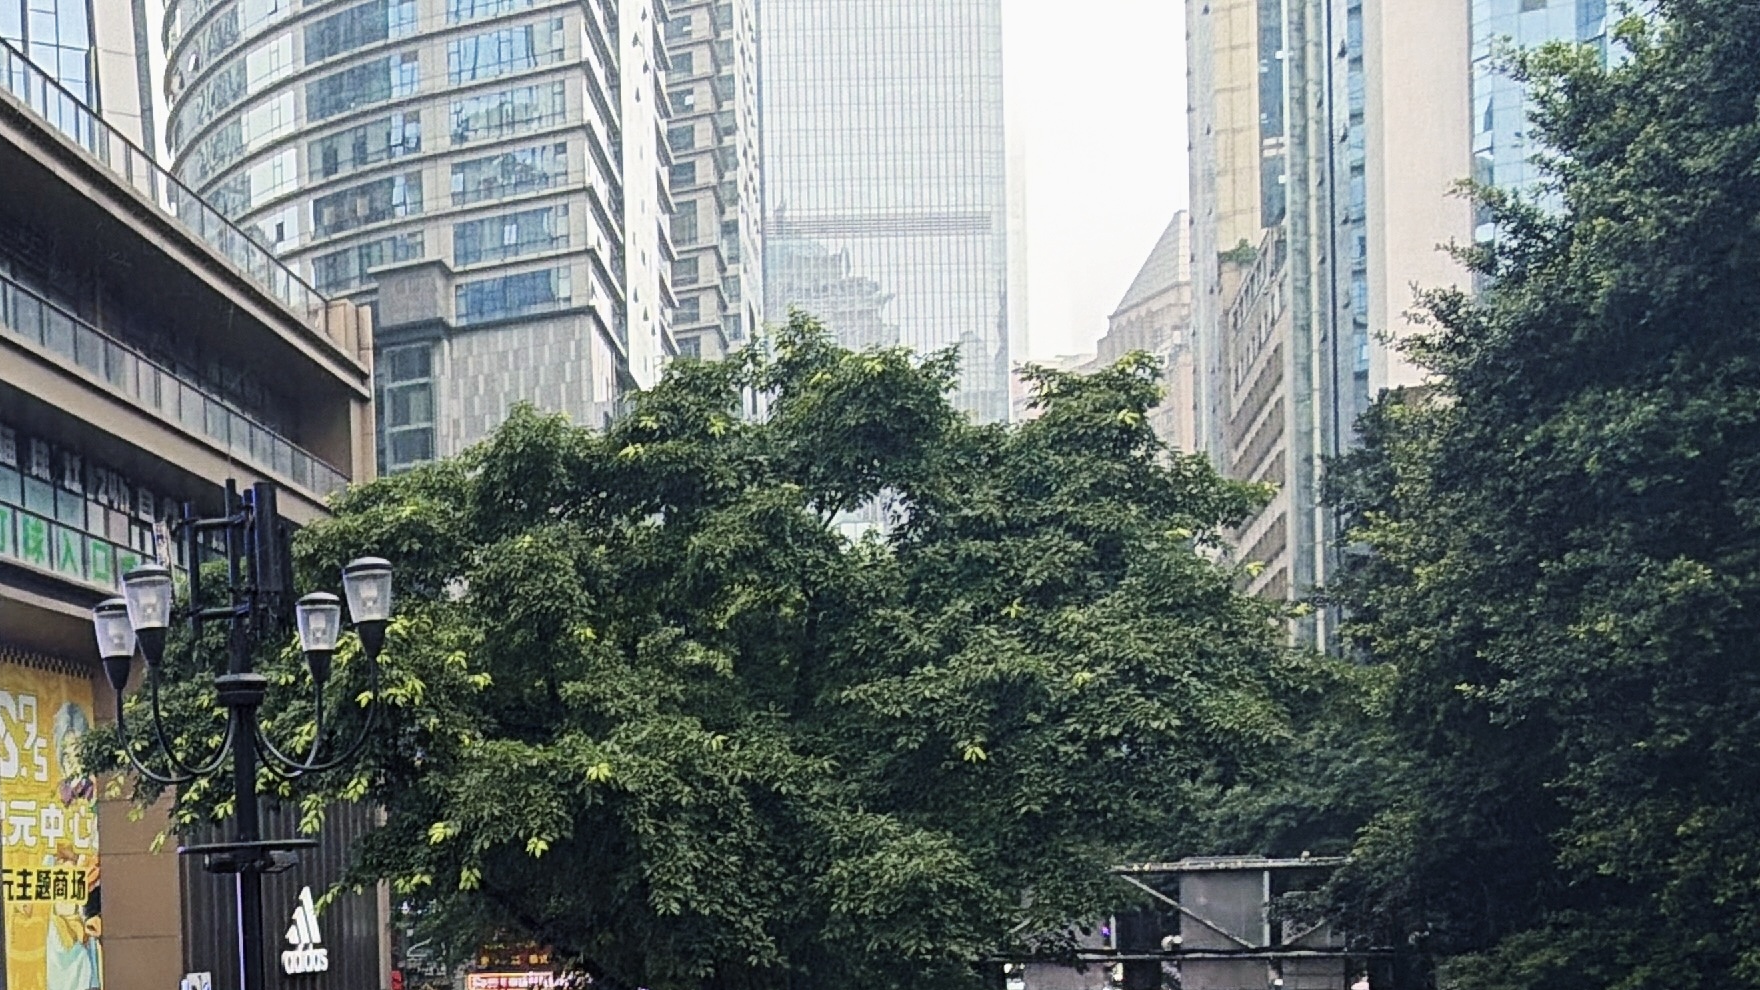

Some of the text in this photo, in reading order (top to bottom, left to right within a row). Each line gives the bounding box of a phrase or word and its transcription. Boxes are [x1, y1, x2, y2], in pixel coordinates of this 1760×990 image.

[1, 800, 98, 849] 元中心
[281, 943, 329, 975] adidas
